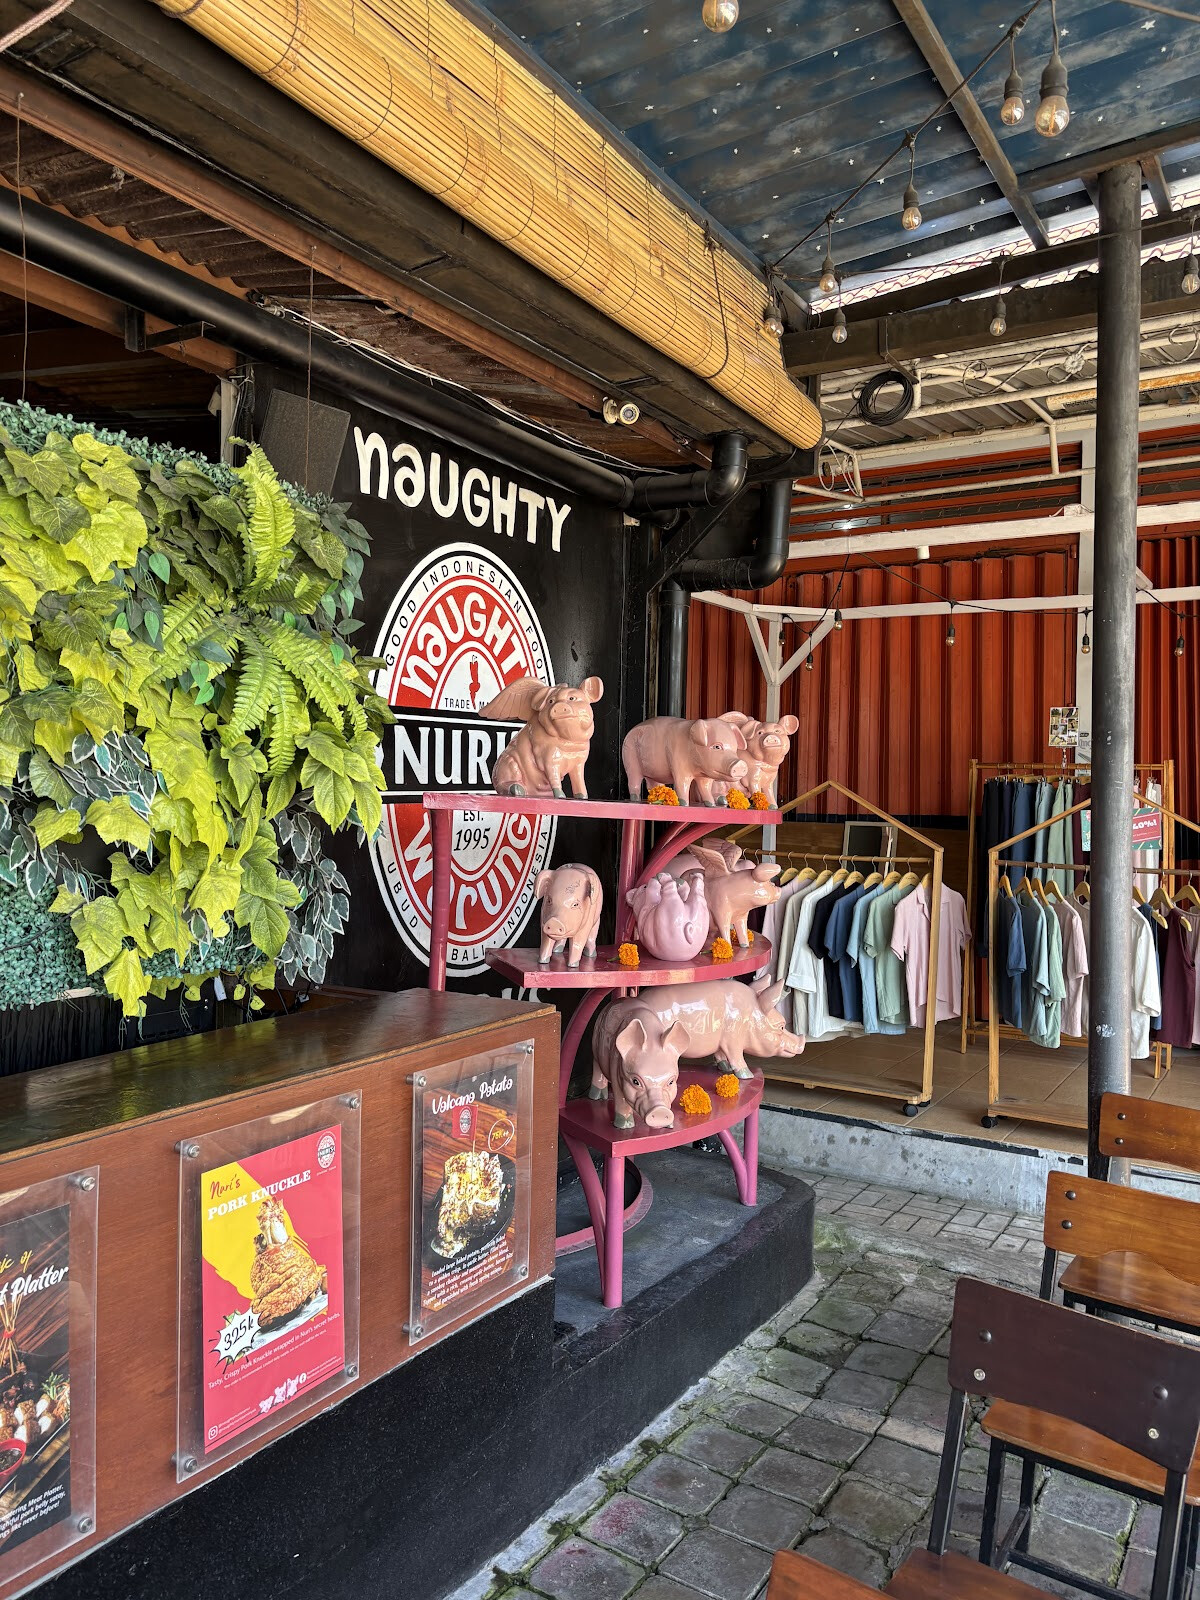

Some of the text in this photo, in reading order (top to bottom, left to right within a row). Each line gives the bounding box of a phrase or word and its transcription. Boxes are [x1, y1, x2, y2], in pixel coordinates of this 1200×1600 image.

[385, 599, 417, 667] GOOD
[422, 560, 522, 614] INDONESIAN
[444, 697, 470, 710] TRADE
[463, 810, 484, 822] EST.
[453, 827, 491, 851] 1995
[387, 831, 548, 962] UBUD BALI INDONESIA
[432, 1075, 513, 1115] Volcano Potato
[207, 1169, 311, 1220] PORK KNUCKLE
[11, 1265, 69, 1304] Platter
[223, 1367, 241, 1381] Crispy
[240, 1360, 253, 1371] Pork
[253, 1350, 273, 1364] Knuckle
[273, 1336, 295, 1353] wrapped
[313, 1319, 327, 1331] secret
[224, 1315, 255, 1351] 325k
[11, 1522, 22, 1532] like
[22, 1512, 39, 1526] never
[39, 1500, 60, 1517] before!
[20, 1507, 35, 1520] pork
[35, 1500, 49, 1512] belly
[28, 1495, 43, 1508] Meat
